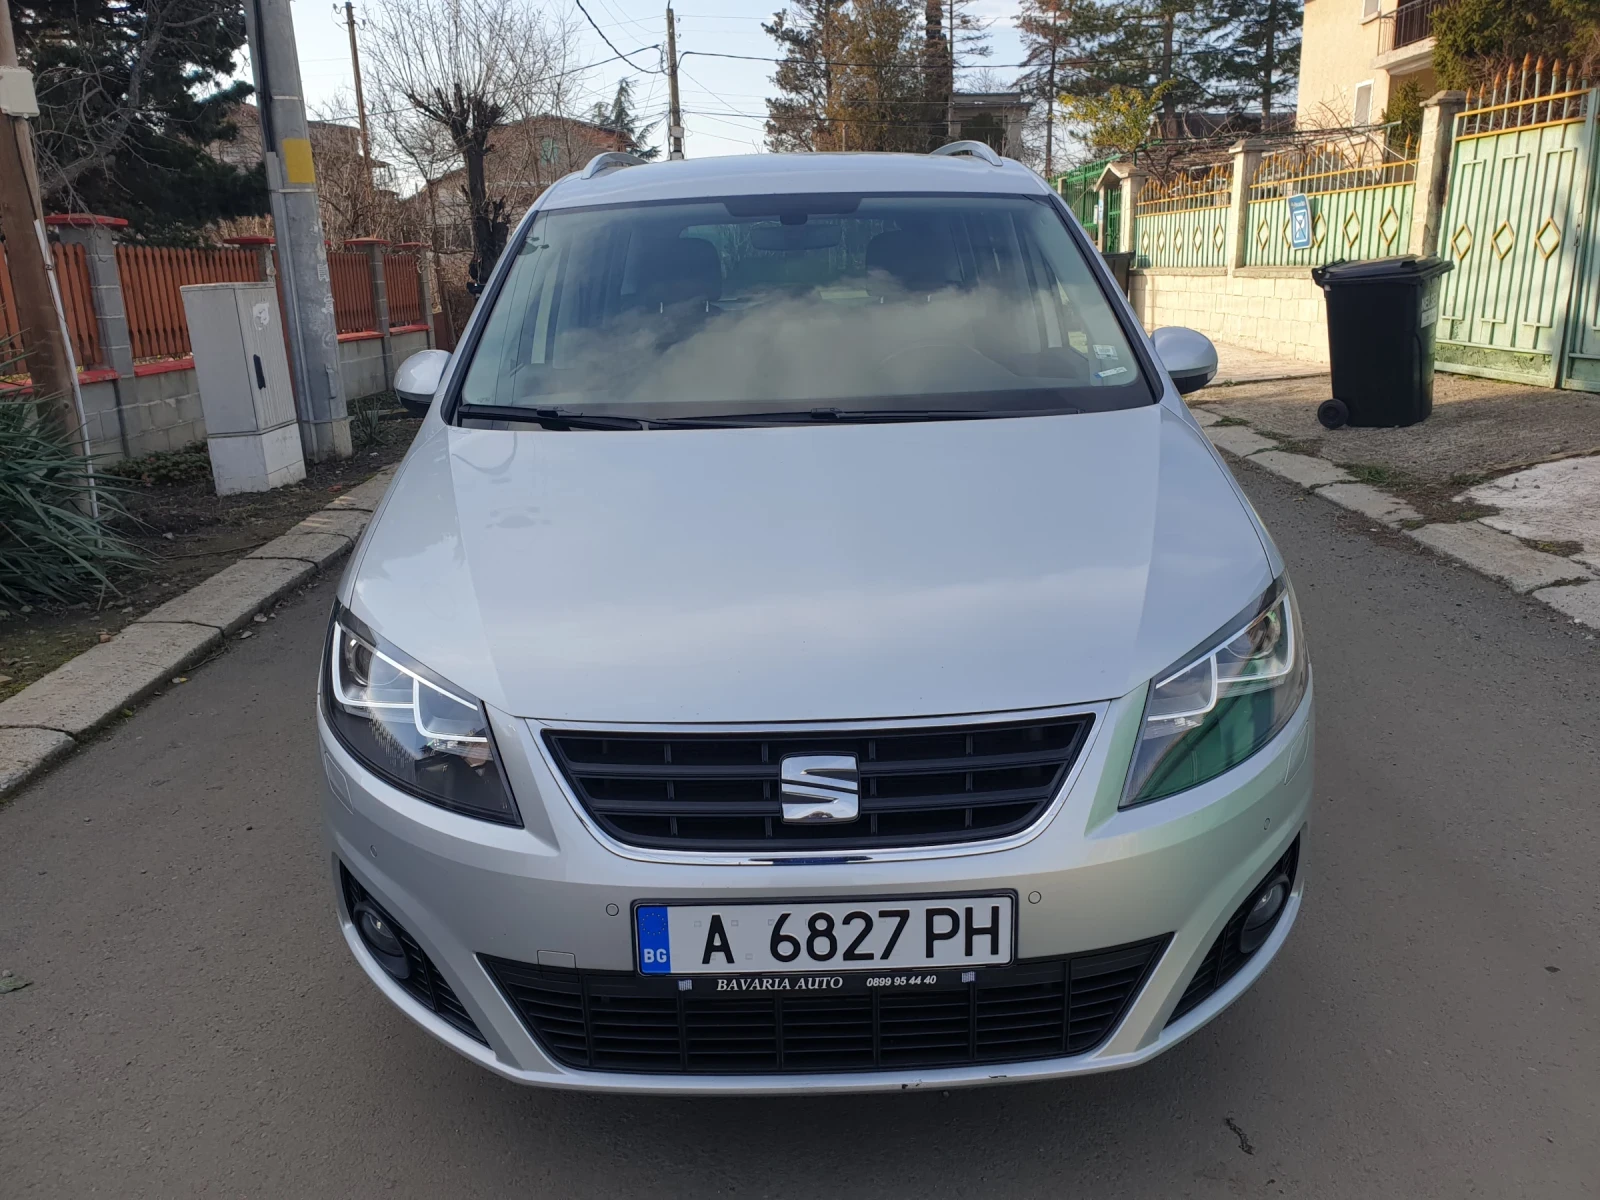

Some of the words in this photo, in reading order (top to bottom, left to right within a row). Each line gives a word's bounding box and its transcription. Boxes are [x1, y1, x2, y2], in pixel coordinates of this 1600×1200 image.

[702, 914, 735, 964] A
[770, 909, 910, 963] 6827
[925, 905, 1000, 958] PH
[643, 948, 668, 963] BG
[716, 978, 792, 991] BAVARIA
[795, 976, 843, 989] AUTO
[866, 977, 892, 987] 0899
[893, 976, 907, 986] 95
[908, 975, 922, 985] 44
[923, 975, 937, 984] 40
